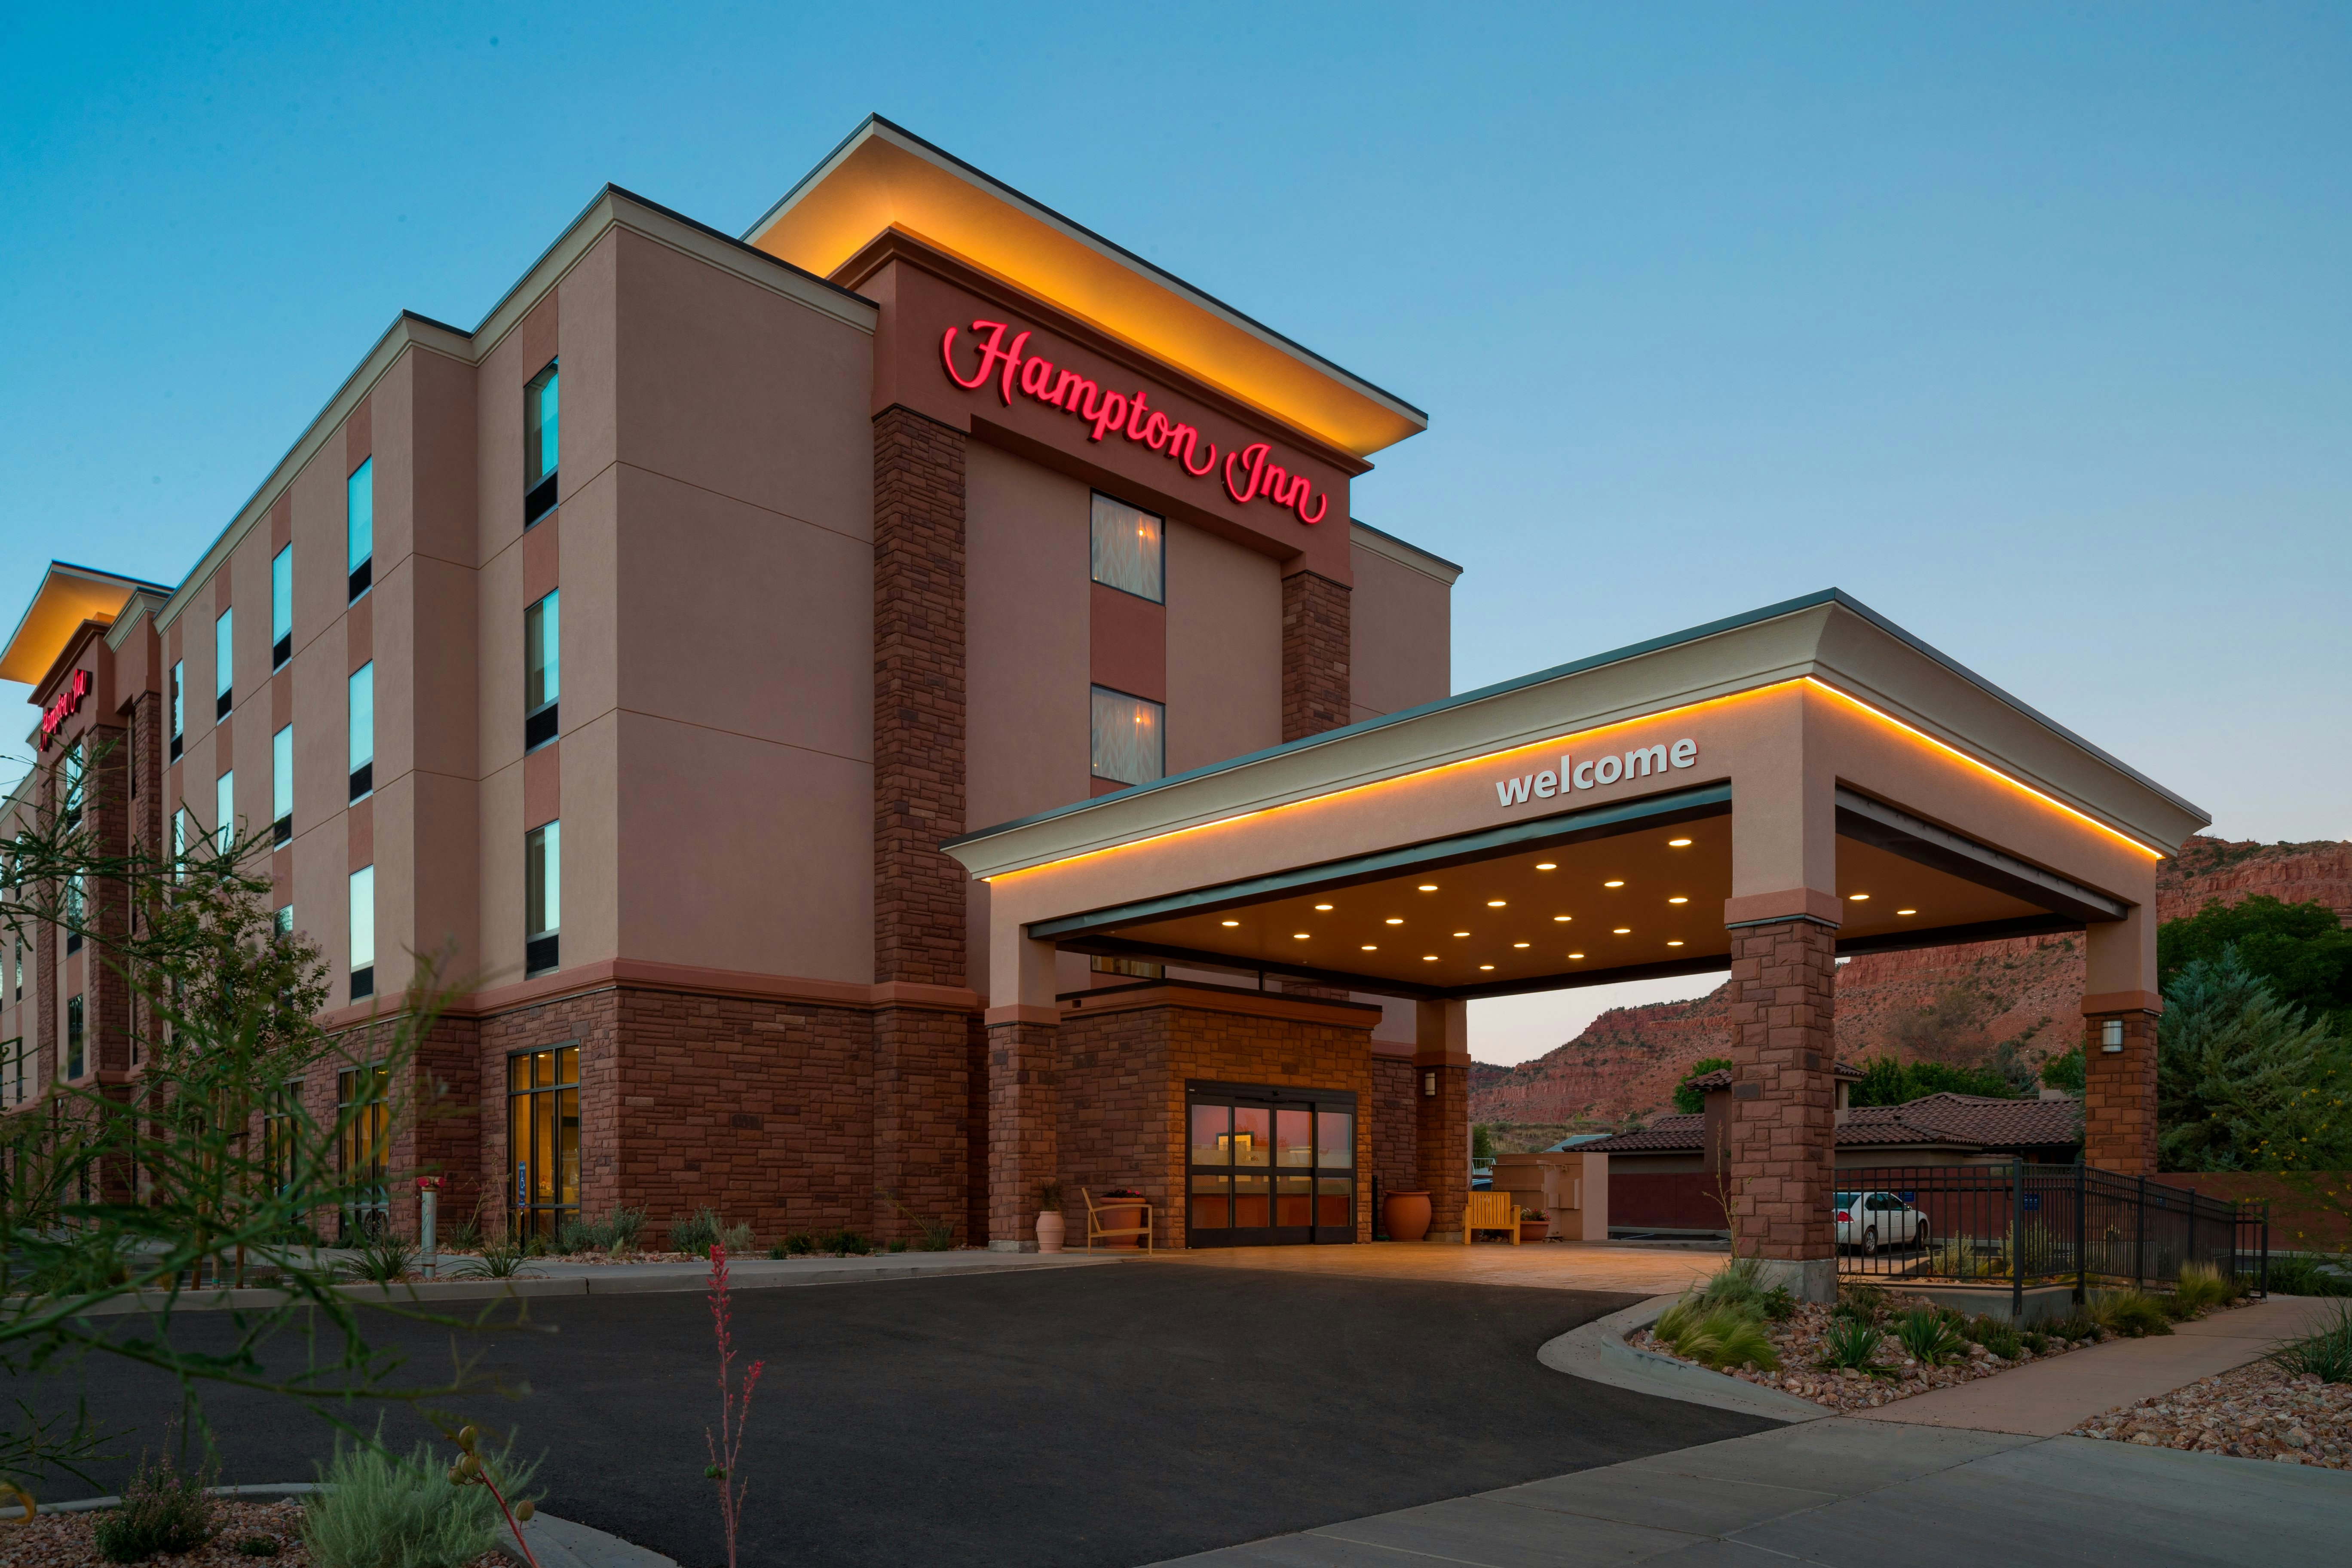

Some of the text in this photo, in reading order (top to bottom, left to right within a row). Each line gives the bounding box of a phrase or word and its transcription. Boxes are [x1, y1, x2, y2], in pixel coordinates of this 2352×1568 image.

[944, 319, 1327, 524] Hampton Inn
[1496, 738, 1697, 807] welcome
